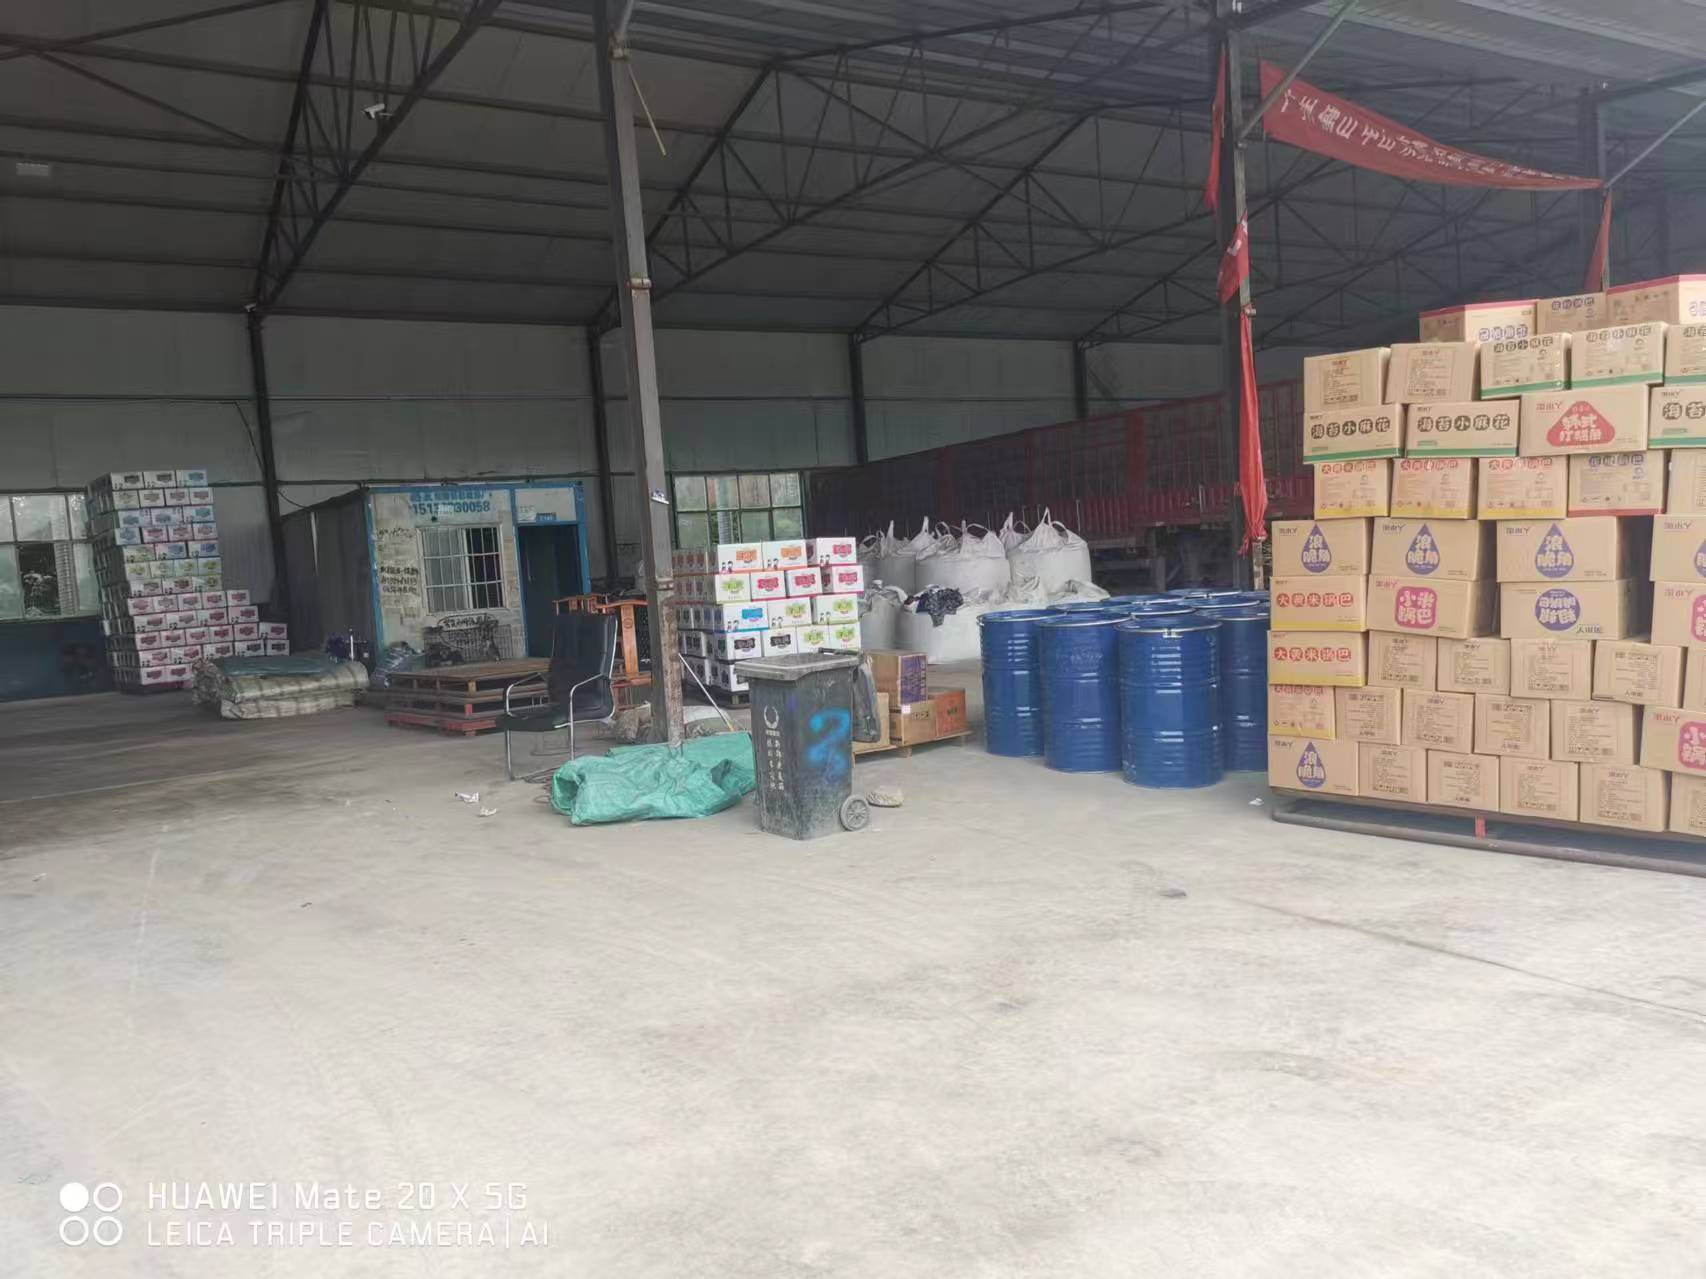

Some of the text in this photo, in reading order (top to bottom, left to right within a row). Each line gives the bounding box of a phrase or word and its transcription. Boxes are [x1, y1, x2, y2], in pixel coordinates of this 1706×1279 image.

[1418, 413, 1511, 433] 海苔小麻花
[1399, 590, 1434, 608] 小米
